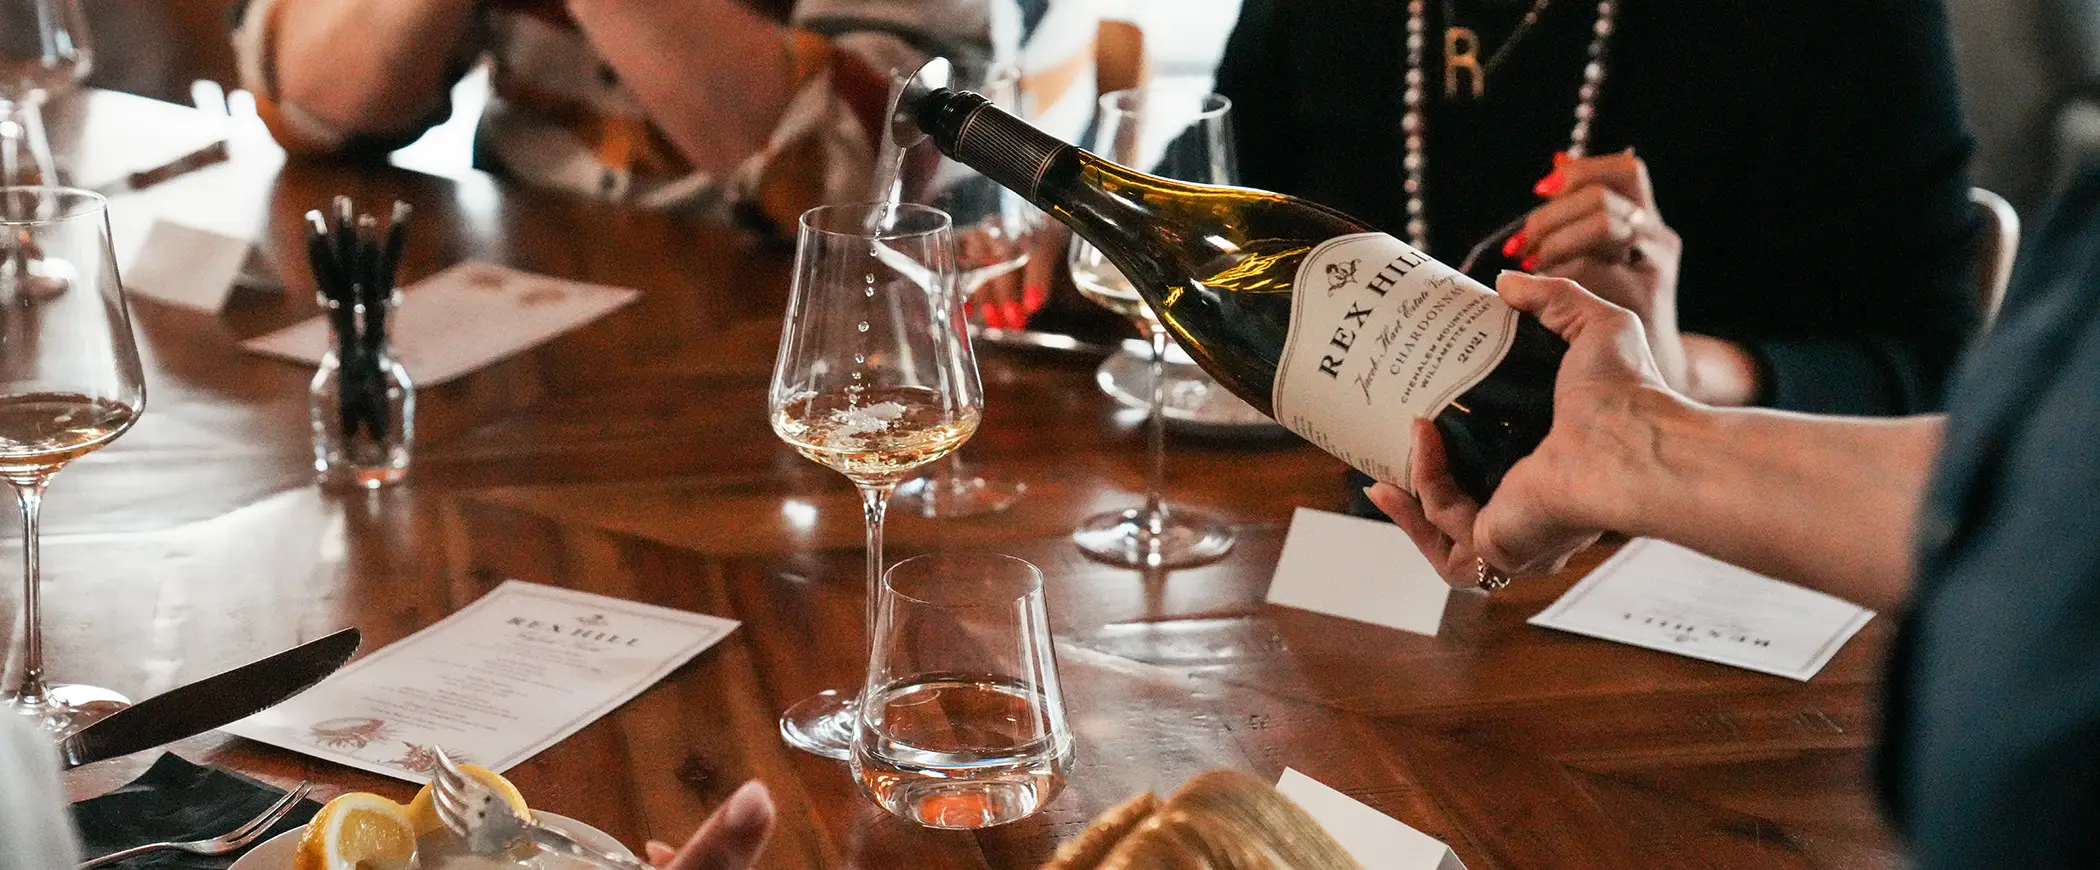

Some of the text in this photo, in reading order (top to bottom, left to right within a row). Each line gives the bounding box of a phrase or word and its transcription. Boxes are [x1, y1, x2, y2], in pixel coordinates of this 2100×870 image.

[1444, 26, 1485, 98] R
[1318, 301, 1374, 380] REX
[1366, 251, 1431, 298] HILL
[1389, 285, 1466, 376] CHARDONNAY
[1397, 291, 1429, 319] Estate
[1401, 298, 1480, 404] CHEHALEM MOUNTAINS
[1421, 302, 1492, 388] WILLAMETTE VALLEY
[1457, 331, 1488, 363] 2021
[505, 616, 567, 634] REX
[571, 628, 639, 647] HILL
